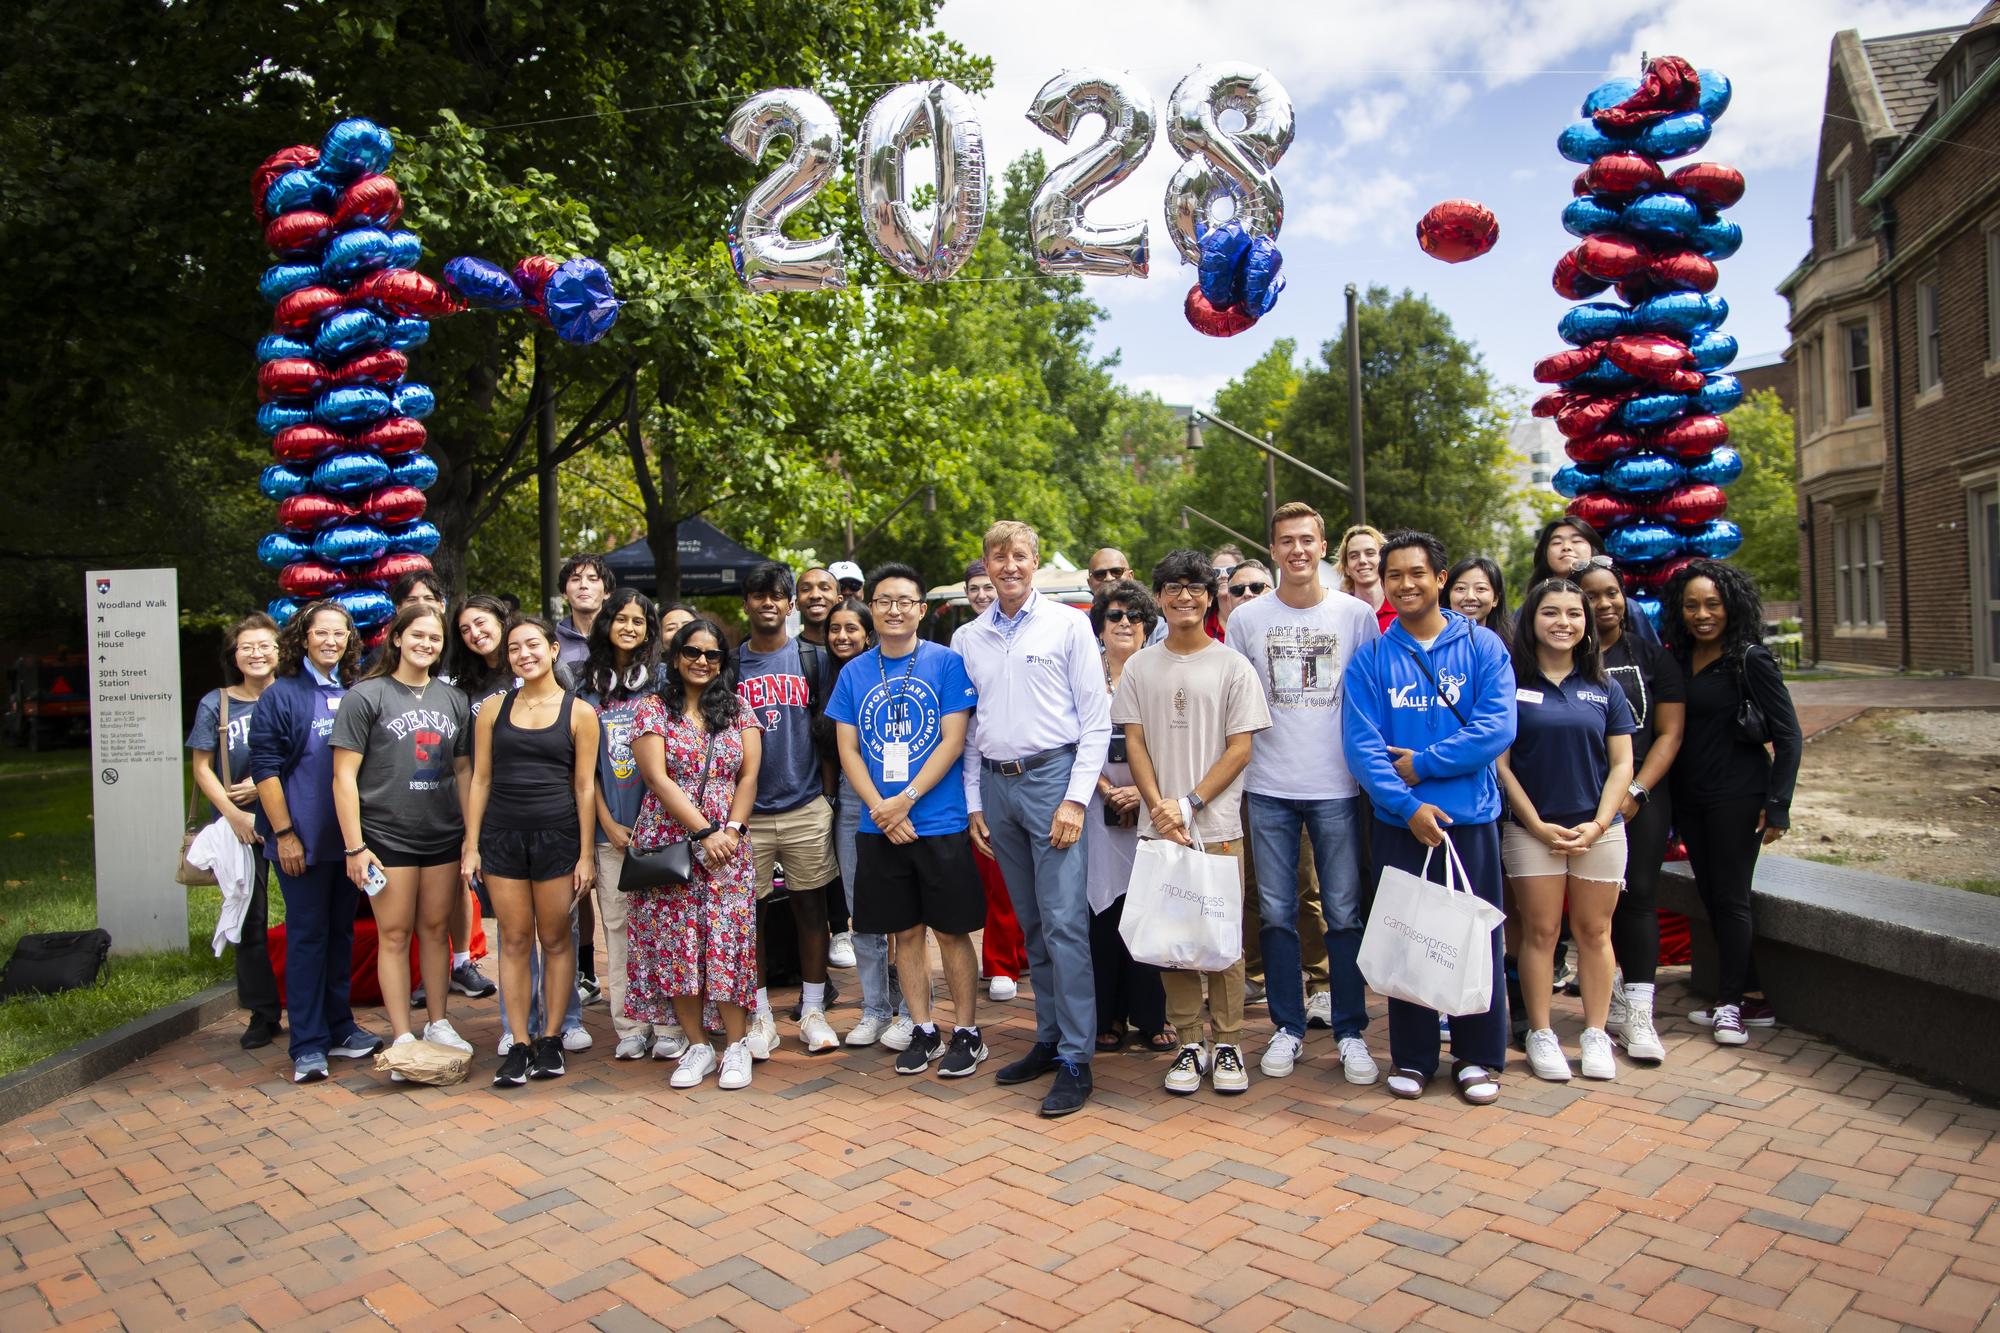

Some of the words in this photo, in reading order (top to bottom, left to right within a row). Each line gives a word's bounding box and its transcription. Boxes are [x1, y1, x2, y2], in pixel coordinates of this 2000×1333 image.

[722, 60, 1296, 293] 2028
[97, 600, 142, 609] Woodland
[145, 599, 167, 608] Walk
[97, 630, 111, 639] Hill
[114, 629, 147, 640] College
[1267, 626, 1293, 637] ART
[97, 640, 125, 648] House
[1034, 655, 1052, 665] Penn
[98, 669, 118, 678] 30th
[121, 669, 147, 677] Street
[98, 679, 130, 687] Station
[99, 693, 127, 702] Drexel
[130, 692, 173, 701] University
[1586, 691, 1608, 704] Penn
[864, 686, 891, 732] SUPPOR
[311, 718, 335, 728] Colleg
[387, 709, 456, 739] PENN
[1383, 916, 1458, 958] campsexpress
